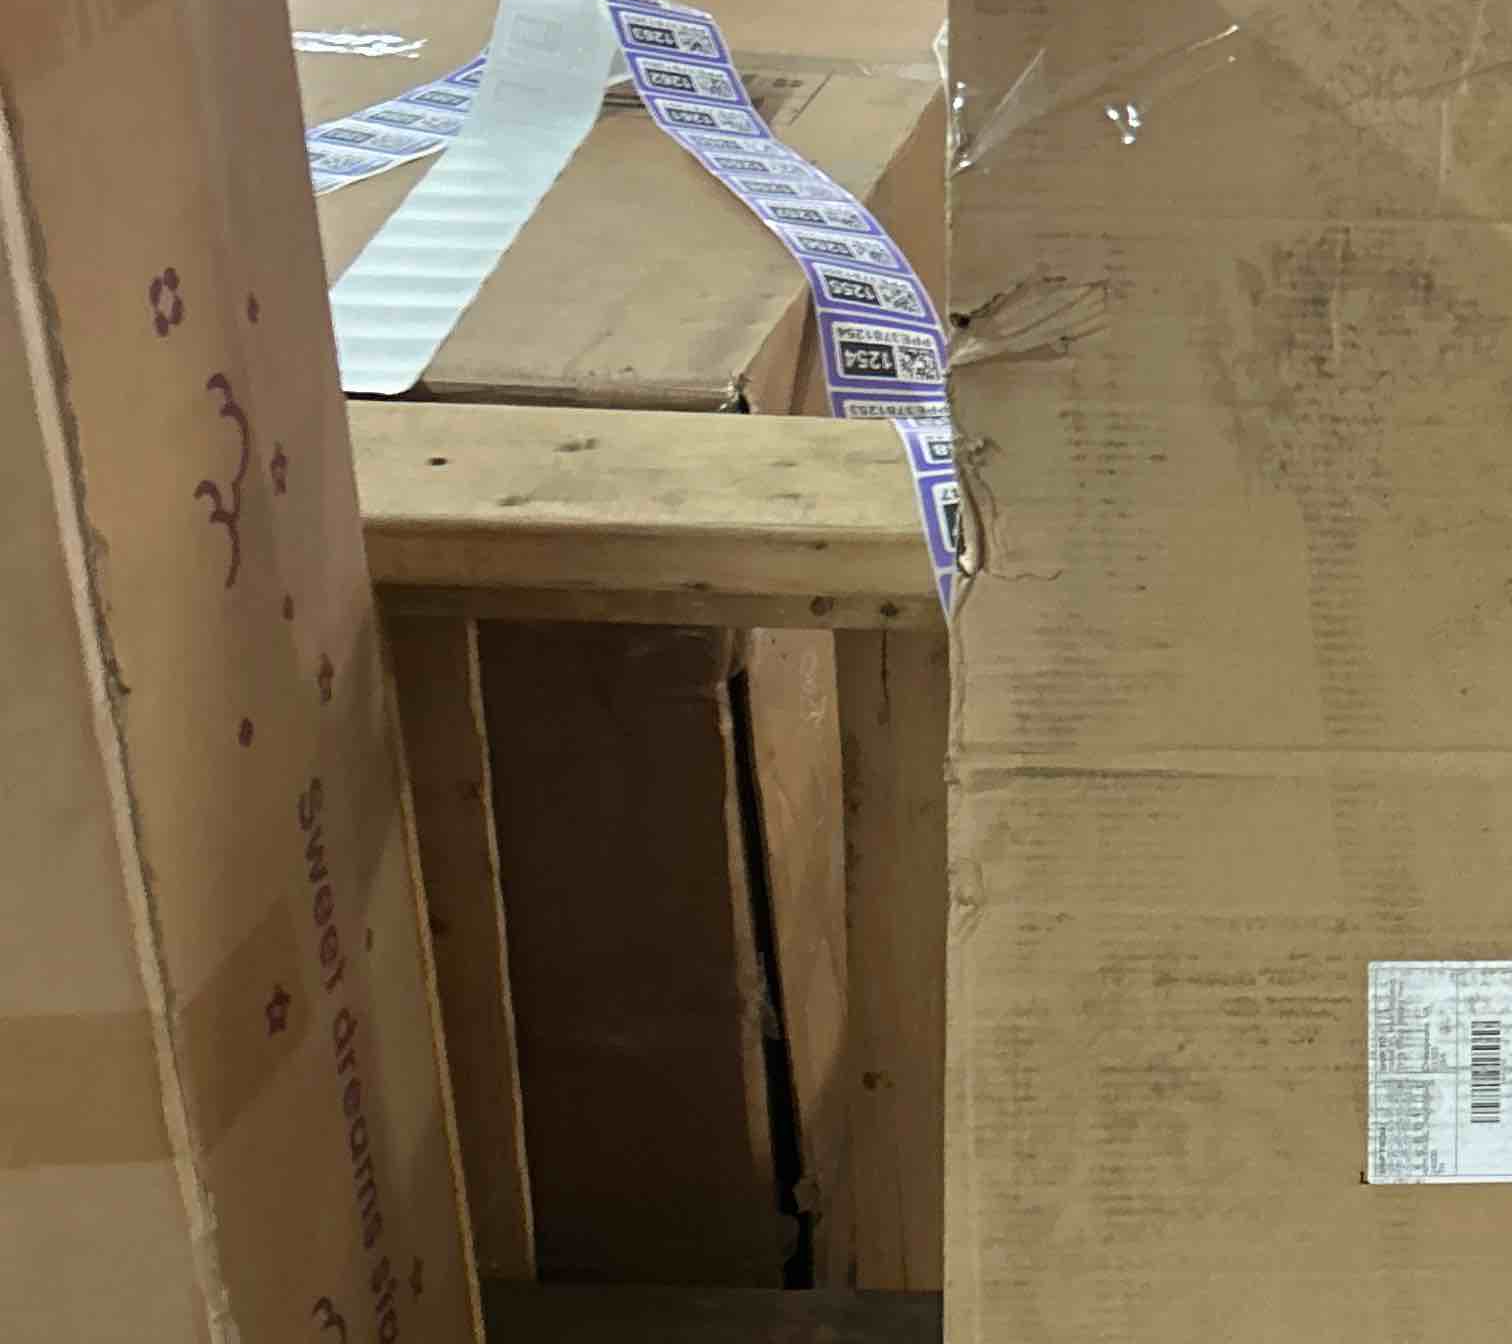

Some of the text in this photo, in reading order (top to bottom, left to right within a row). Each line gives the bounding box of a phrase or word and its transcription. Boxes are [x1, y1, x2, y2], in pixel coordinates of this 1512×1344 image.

[843, 349, 894, 370] 1254
[297, 777, 345, 992] Sweet
[333, 1007, 385, 1249] dreams
